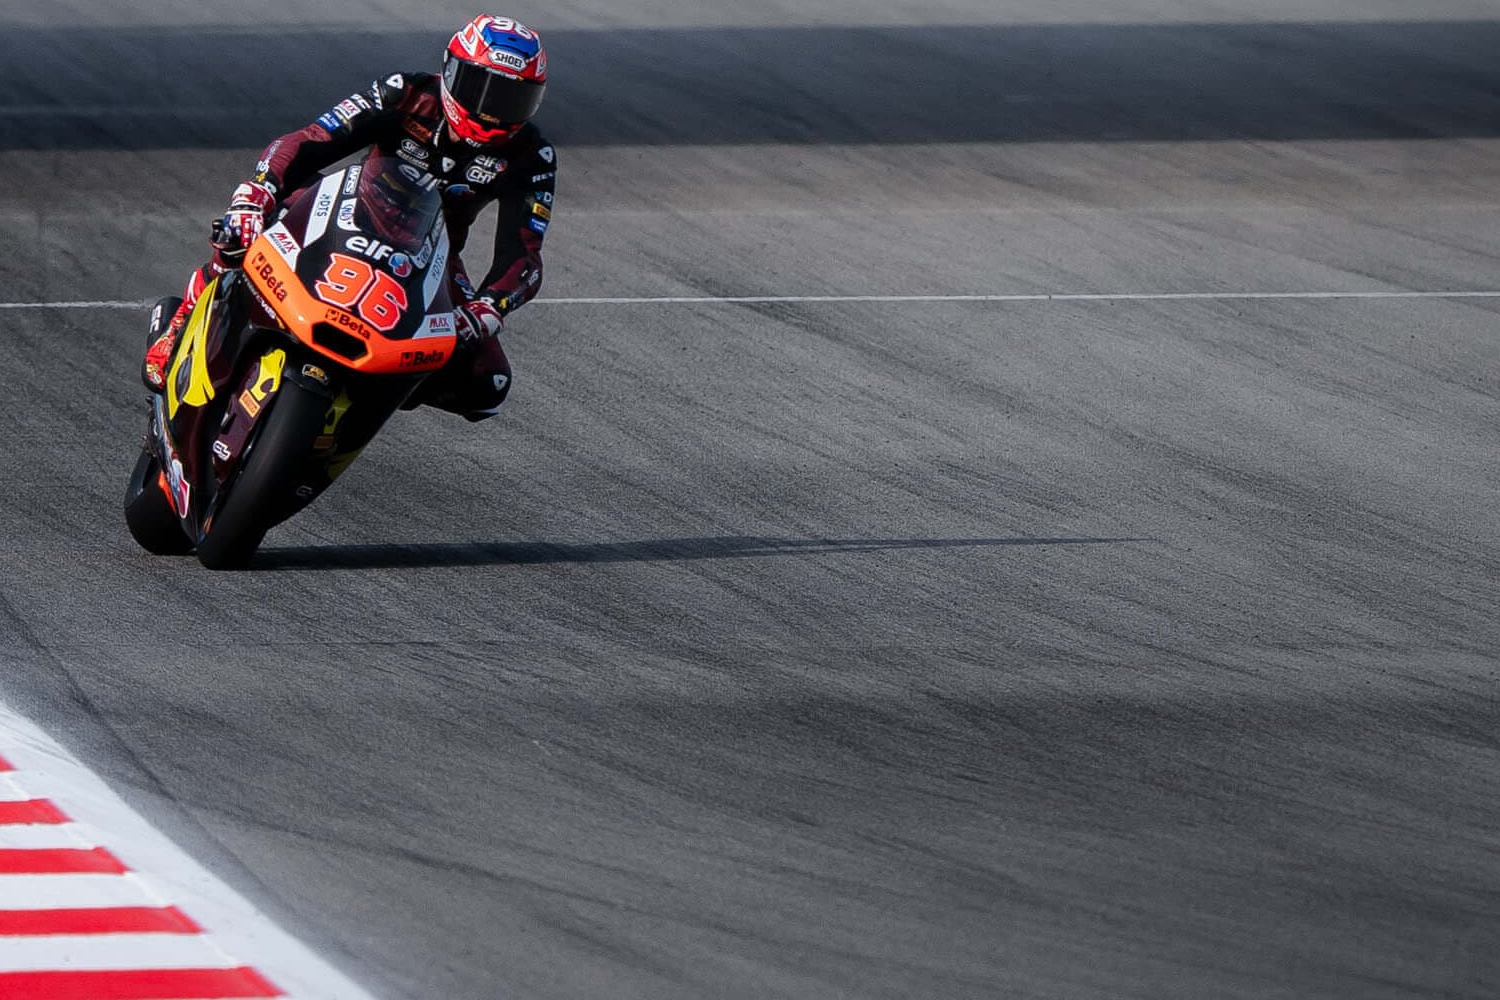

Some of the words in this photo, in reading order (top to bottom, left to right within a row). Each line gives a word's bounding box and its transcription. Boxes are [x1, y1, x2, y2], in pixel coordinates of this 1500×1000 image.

[495, 52, 523, 68] SHOEI
[474, 155, 497, 168] elf
[275, 232, 297, 252] MAX
[345, 236, 394, 260] elf
[260, 263, 288, 303] Beta
[315, 253, 409, 331] 96
[338, 312, 371, 340] Beta
[429, 317, 448, 329] MAX
[413, 350, 445, 366] Beta
